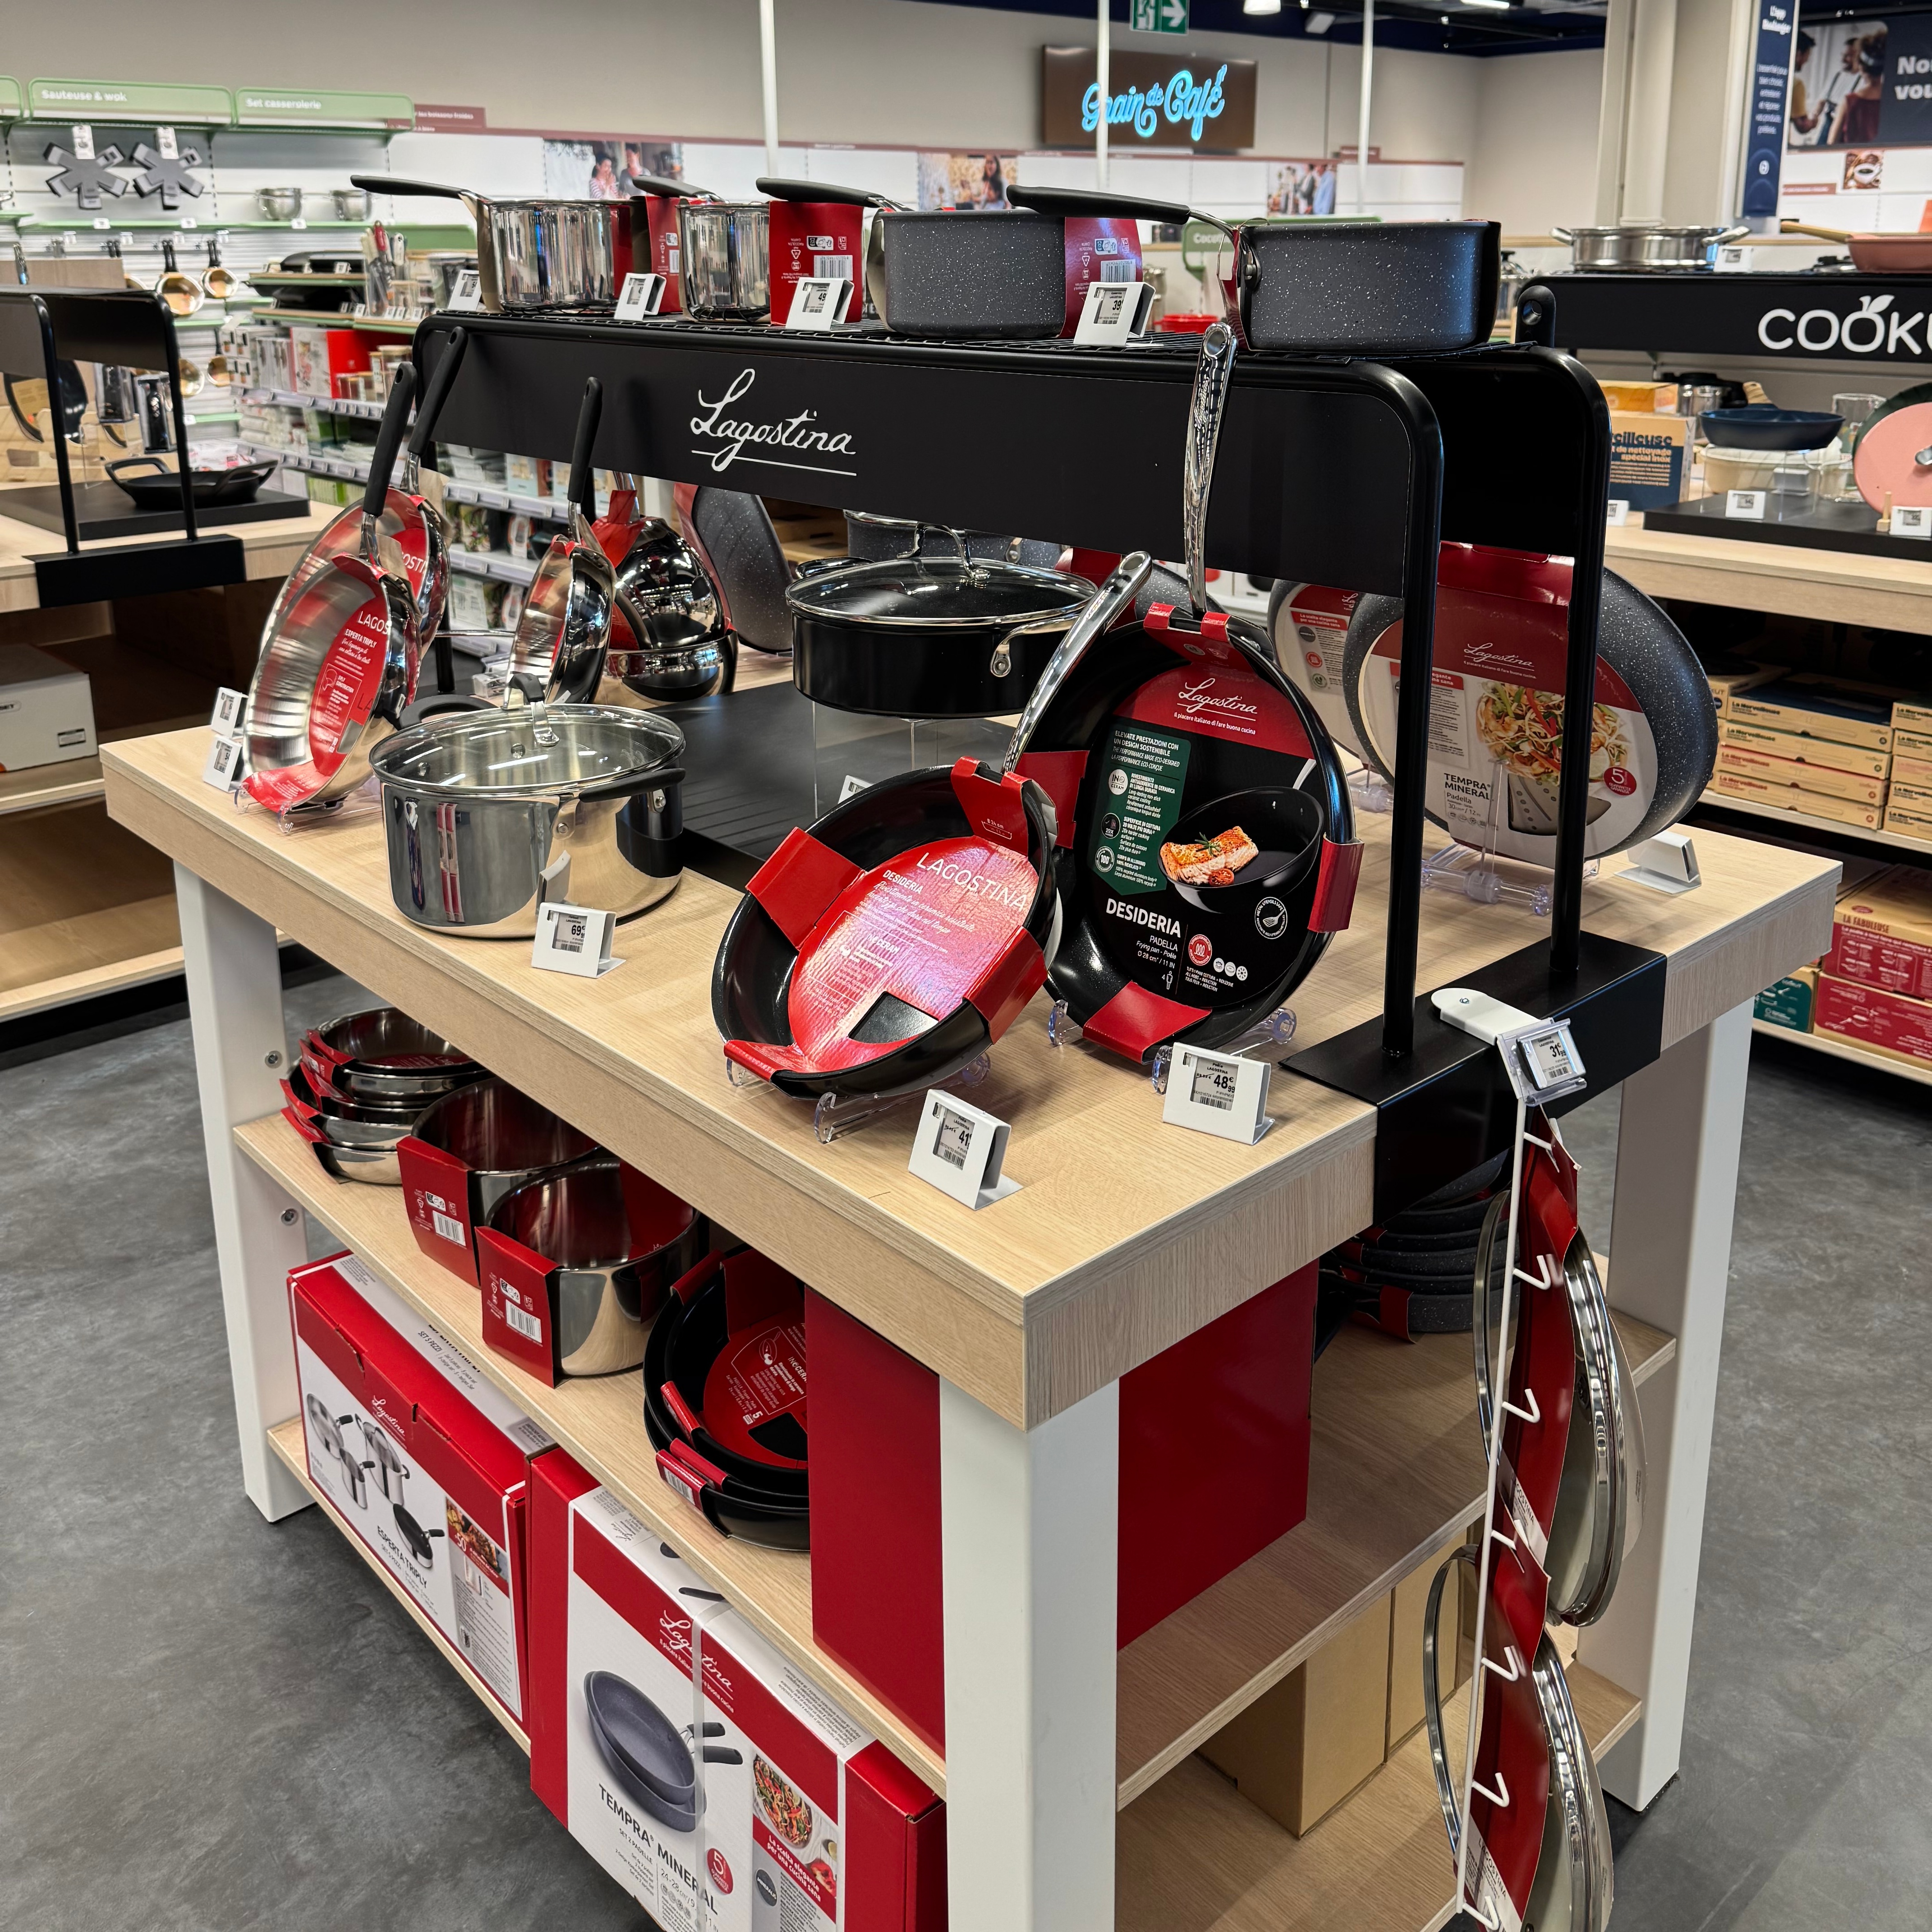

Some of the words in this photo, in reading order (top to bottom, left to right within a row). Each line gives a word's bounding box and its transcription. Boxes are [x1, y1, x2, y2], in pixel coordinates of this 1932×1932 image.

[1897, 55, 1932, 75] No
[41, 89, 92, 101] Sauteuse
[105, 92, 127, 101] wok
[245, 98, 262, 108] Set
[1082, 83, 1157, 137] Grain
[1164, 64, 1227, 141] Café
[1758, 308, 1932, 354] COOK
[690, 369, 856, 472] Lagostina
[1612, 432, 1672, 445] eilleuse
[1464, 643, 1535, 667] Lagostina
[1178, 678, 1257, 713] Lagostina
[1194, 716, 1210, 725] italiano
[1216, 720, 1226, 729] fare
[1227, 723, 1240, 731] buona
[1241, 727, 1256, 735] cucina
[1115, 731, 1136, 741] ELEVATE
[1136, 735, 1167, 747] PRESTAZIONI
[1122, 740, 1139, 750] DESIGN
[1140, 744, 1171, 757] SOSTENIBILE
[1611, 768, 1624, 784] 5
[1445, 781, 1490, 800] MINERAL
[1447, 792, 1472, 804] Padella
[883, 869, 924, 894] DESIDERIA
[916, 852, 1028, 912] LAGOSTINA
[1106, 898, 1181, 938] DESIDERIA
[1843, 914, 1851, 924] LA
[1853, 916, 1889, 934] FABULEUSE
[1136, 940, 1150, 951] Frying
[1150, 935, 1178, 952] PADELLA
[372, 1395, 405, 1437] Lagostina
[377, 1525, 405, 1563] ESPERTA
[405, 1556, 427, 1589] TRIPLY
[660, 1610, 733, 1692] Lagtina
[713, 1850, 723, 1875] 5
[767, 1842, 777, 1855] per
[777, 1853, 789, 1868] una
[789, 1865, 807, 1887] cucina
[807, 1884, 821, 1902] sana
[769, 1835, 776, 1846] La
[777, 1844, 794, 1864] scelta
[794, 1862, 820, 1892] elegante
